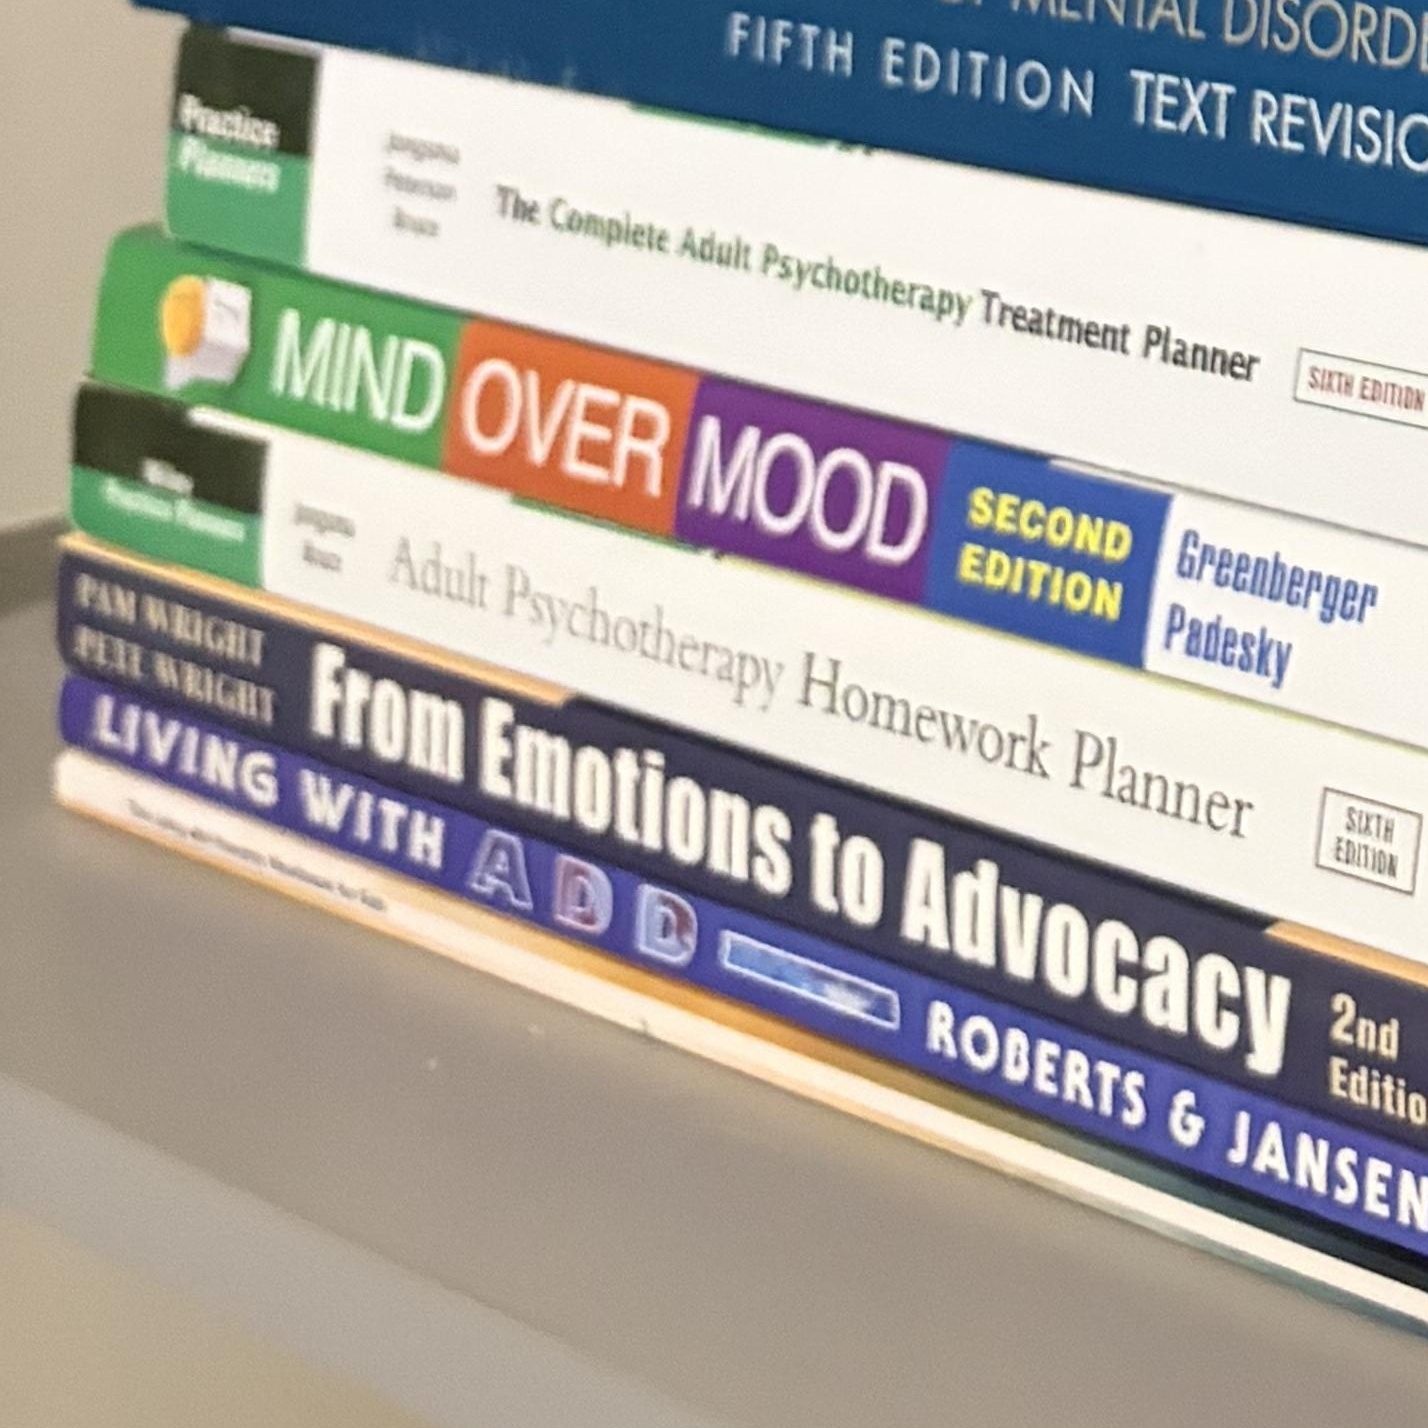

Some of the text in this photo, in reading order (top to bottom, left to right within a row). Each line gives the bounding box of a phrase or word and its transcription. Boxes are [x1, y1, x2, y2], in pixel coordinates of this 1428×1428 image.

[726, 12, 855, 78] FIFTH
[882, 38, 1096, 118] EDITION
[1130, 69, 1239, 141] TEXT
[496, 183, 541, 227] The
[549, 197, 670, 256] Complete
[678, 224, 752, 273] Adult
[761, 244, 973, 329] Psychotherapy
[981, 288, 1130, 358] Treatment
[1143, 323, 1260, 384] Planner
[1308, 365, 1427, 414] SIXTH EDITION
[270, 308, 928, 568] MIND OVER MOOD
[968, 485, 1134, 563] SECOND
[959, 548, 1123, 623] EDITION
[1177, 529, 1379, 627] Greenberger
[140, 594, 265, 667] WRIGHT
[1164, 603, 1293, 690] Padesky
[153, 650, 275, 726] WRIGHT
[389, 534, 1255, 841] Adult Psychotherapy Homework Planner
[93, 693, 280, 807] LIVING
[299, 768, 447, 869] WITH
[311, 642, 466, 784] From
[481, 694, 793, 900] Emotions
[812, 803, 885, 928] to
[900, 839, 1293, 1078] Advocacy
[1333, 837, 1399, 880] EDITION
[1344, 805, 1397, 845] SIXTH
[1329, 992, 1400, 1061] 2nd
[926, 1001, 1148, 1126] ROBERTS
[1170, 1090, 1204, 1140] &
